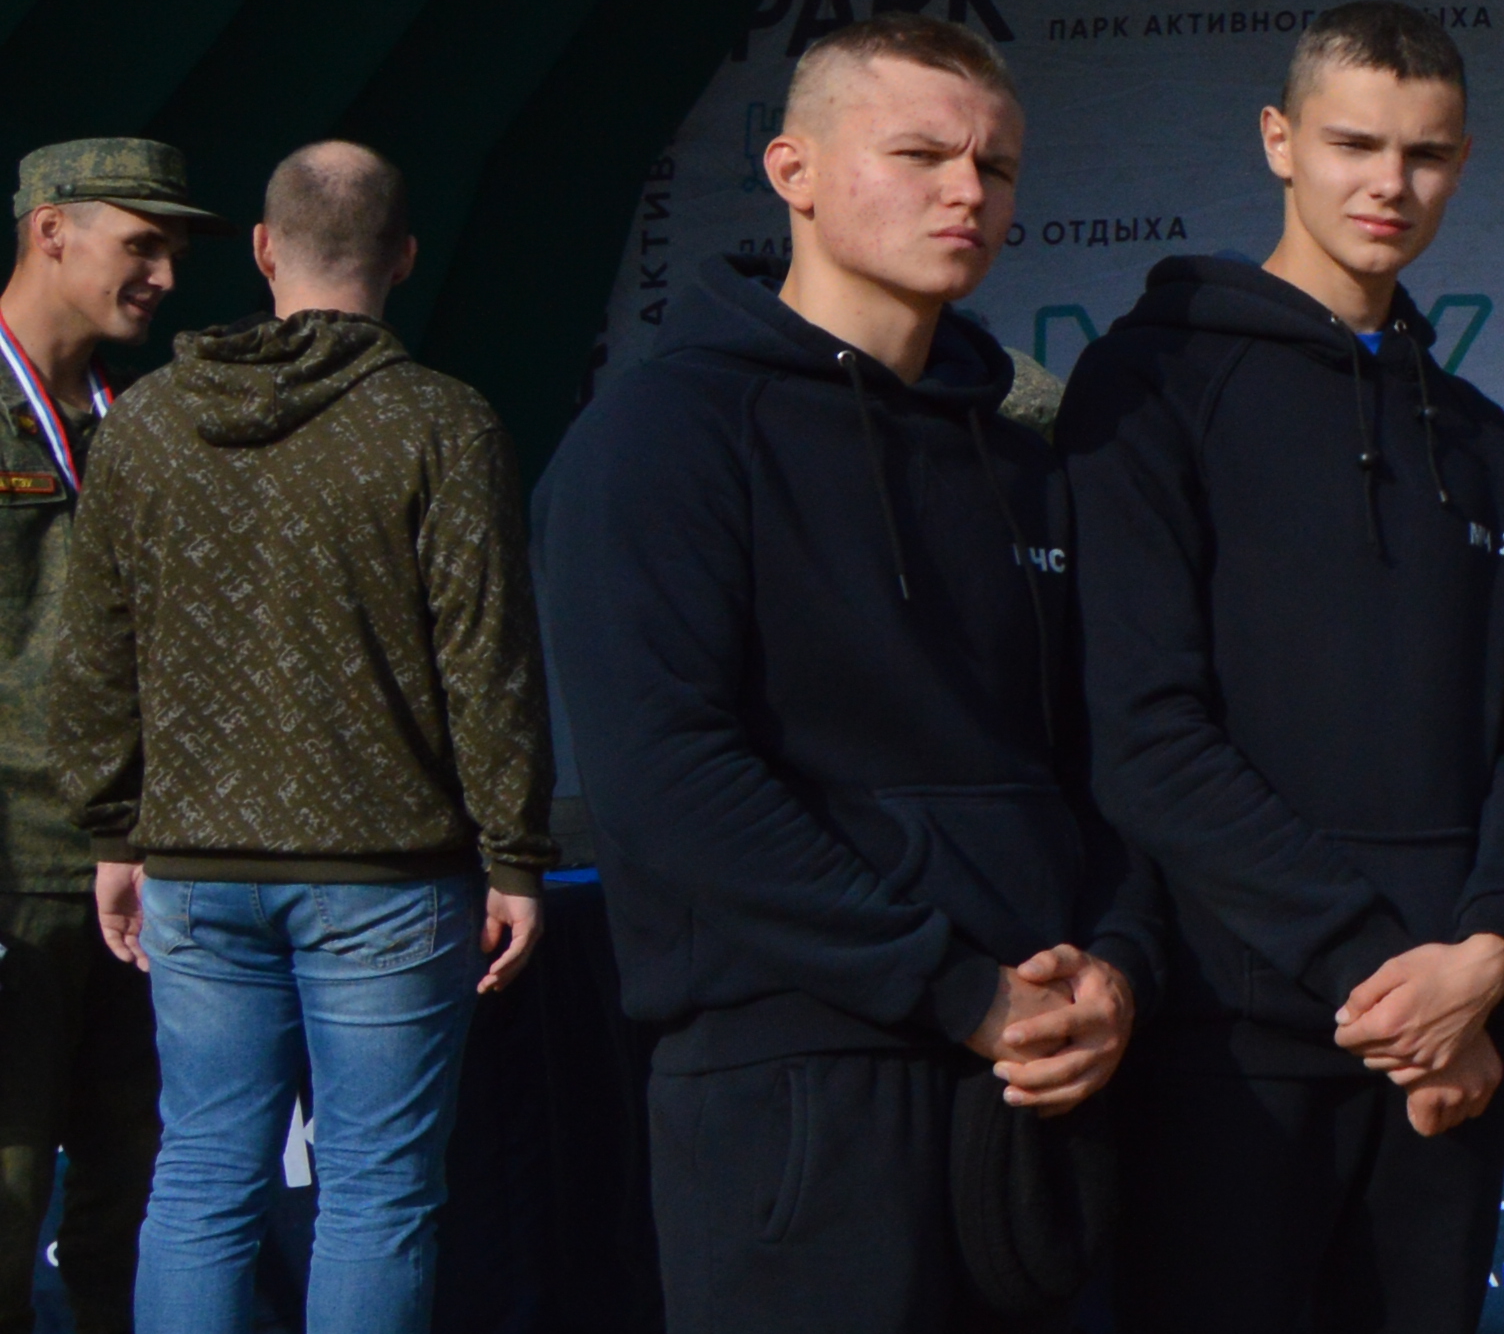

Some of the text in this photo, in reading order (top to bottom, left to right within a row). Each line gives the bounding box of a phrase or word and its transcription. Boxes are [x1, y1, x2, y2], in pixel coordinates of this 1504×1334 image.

[1048, 16, 1130, 42] ПАРК
[1143, 9, 1324, 37] АКТИВНОГ
[1041, 214, 1188, 247] ОТДЫХА
[1012, 542, 1067, 574] ЧС
